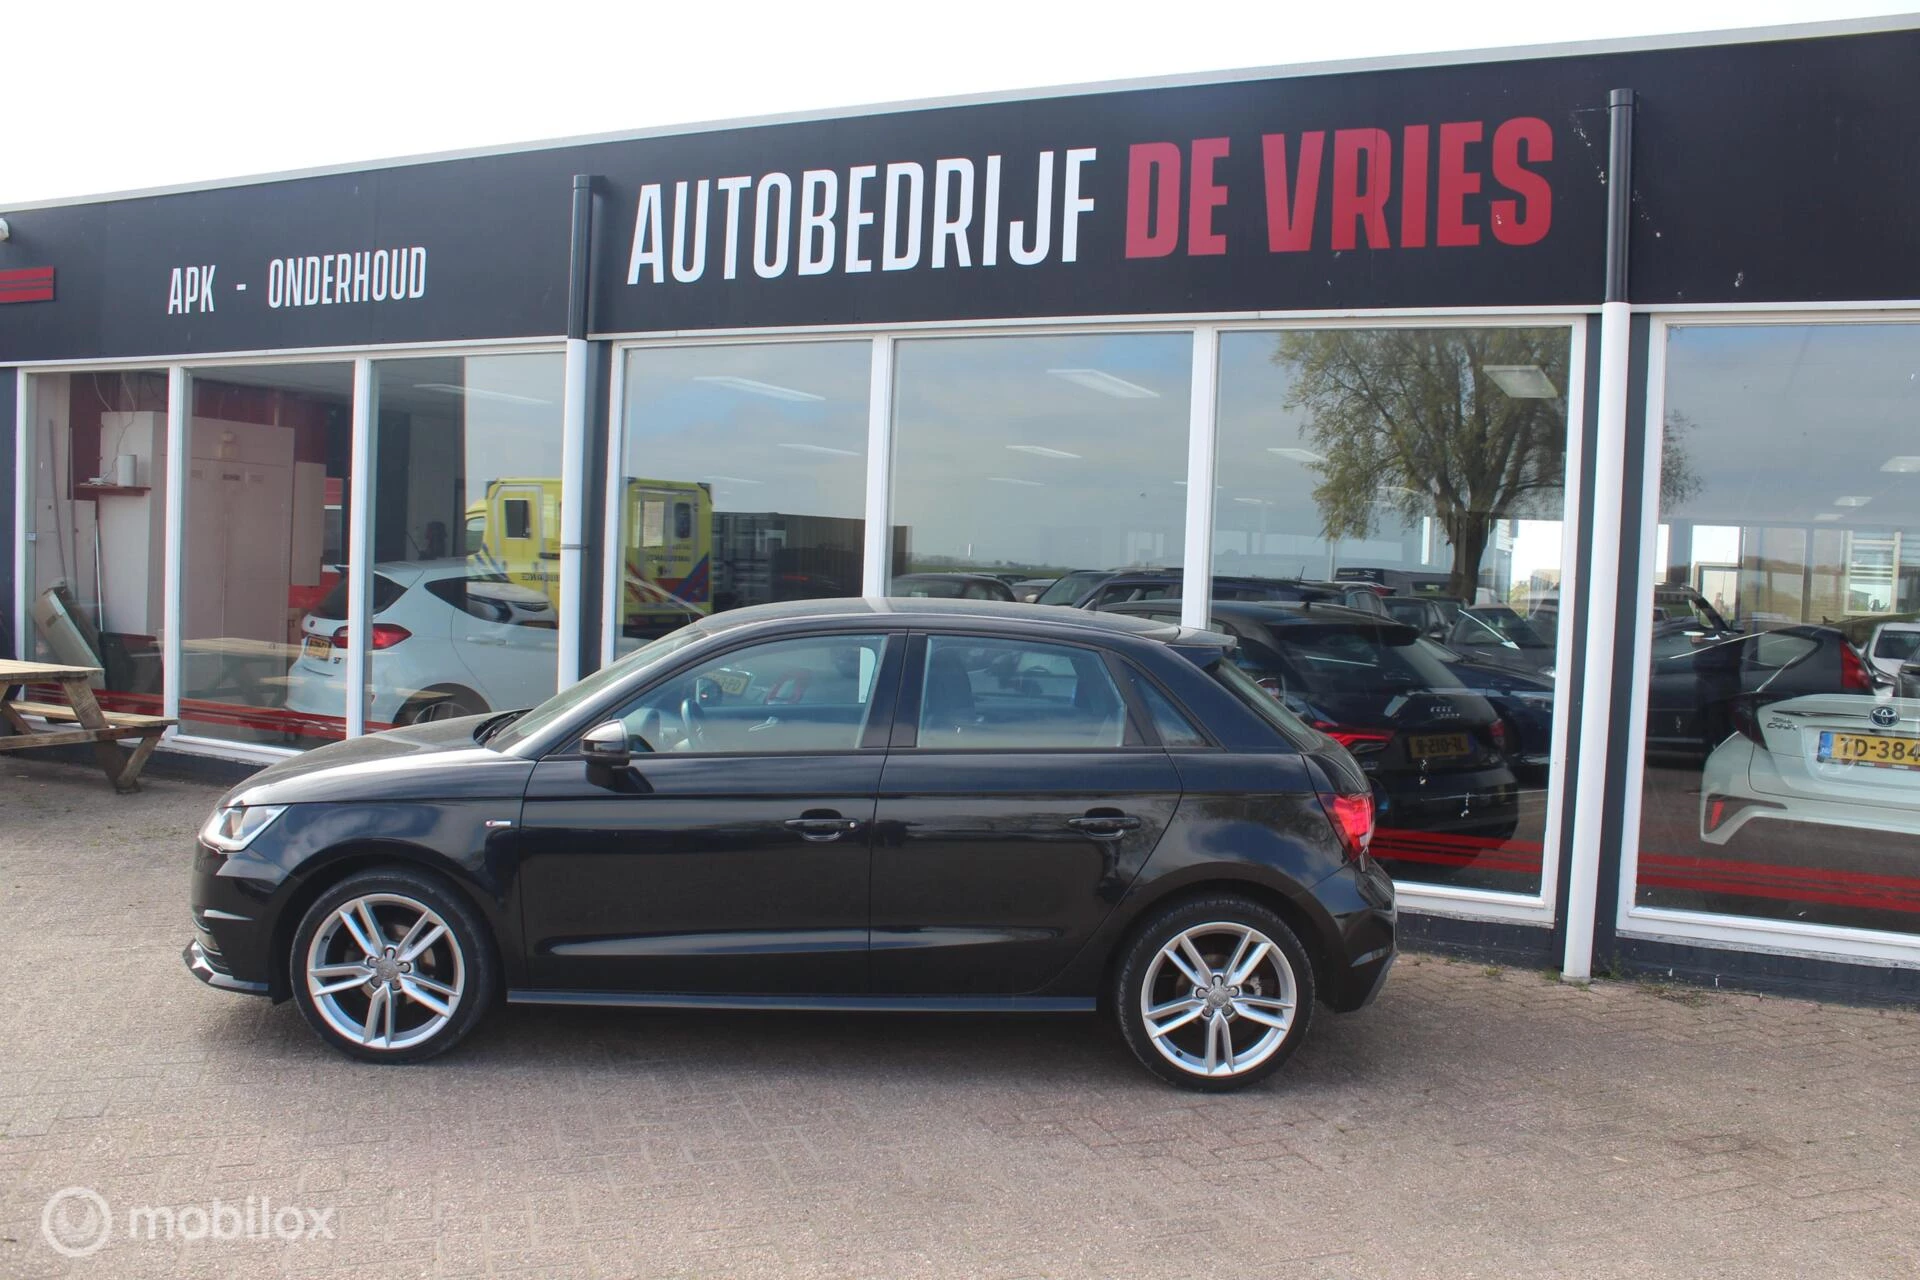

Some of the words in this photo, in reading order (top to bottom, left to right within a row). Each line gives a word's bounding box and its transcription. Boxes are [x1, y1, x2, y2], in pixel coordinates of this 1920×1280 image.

[626, 147, 1097, 285] AUTOBEDRIJF
[1125, 136, 1230, 259] DE
[1261, 116, 1553, 253] VRIES
[168, 264, 216, 315] APK
[267, 246, 427, 309] ONDERHOUD
